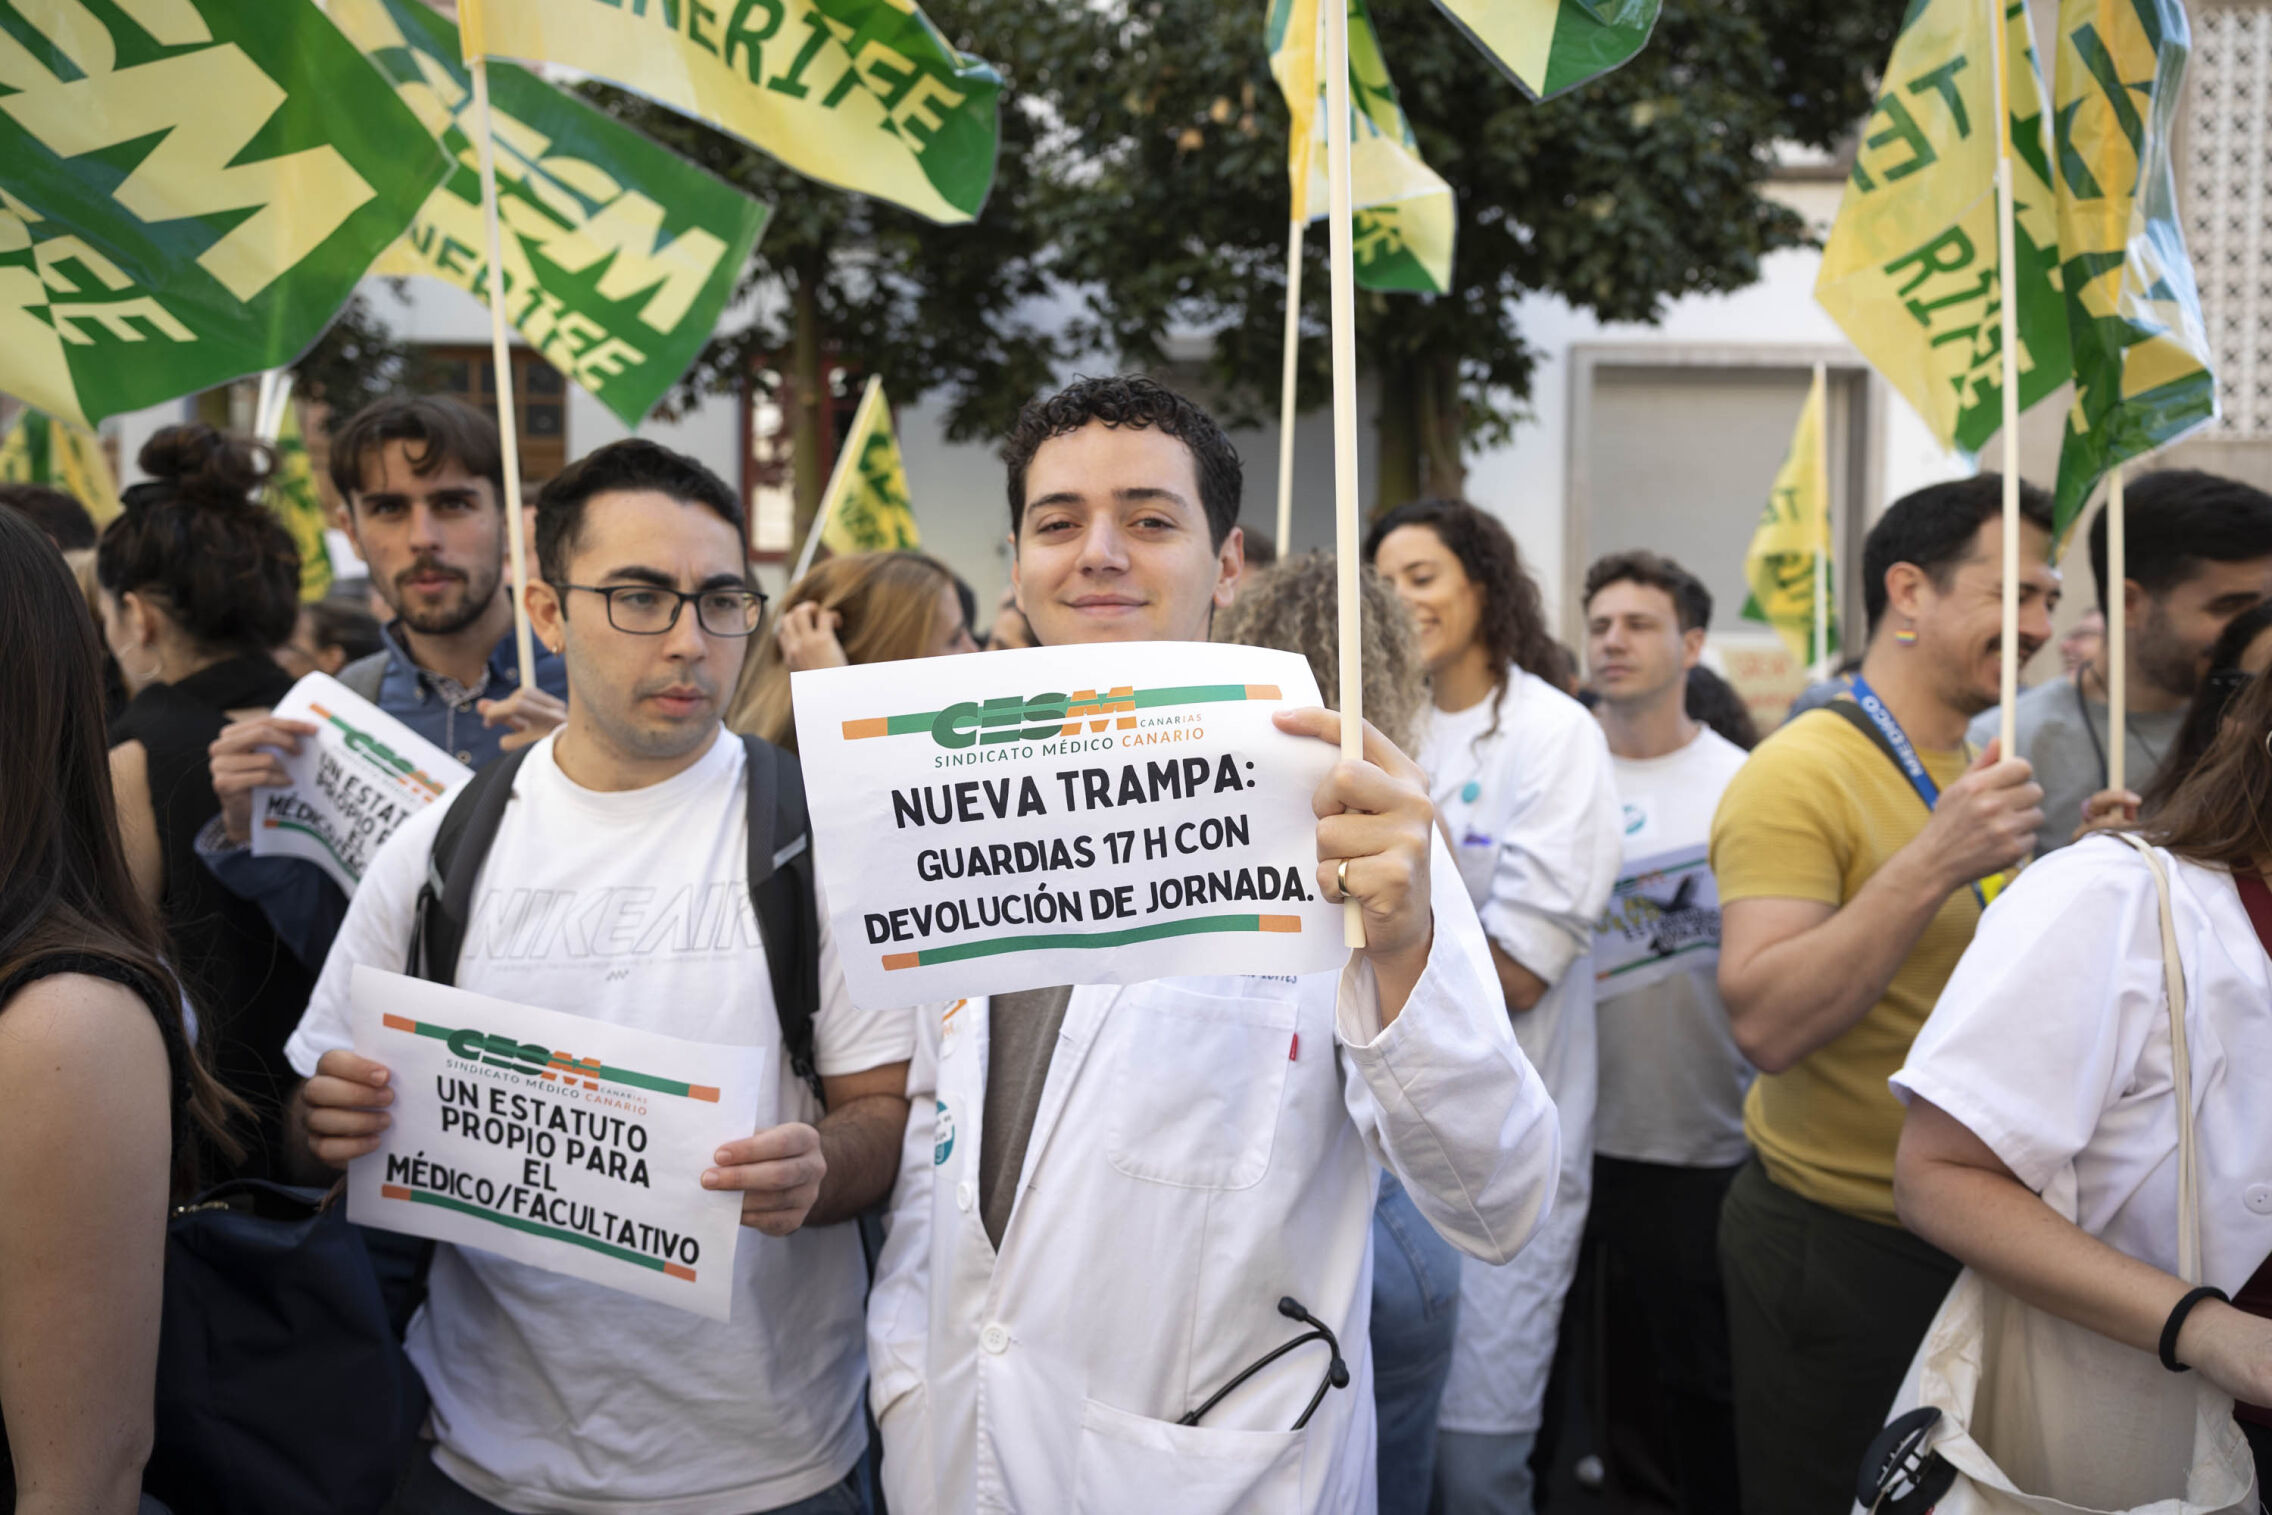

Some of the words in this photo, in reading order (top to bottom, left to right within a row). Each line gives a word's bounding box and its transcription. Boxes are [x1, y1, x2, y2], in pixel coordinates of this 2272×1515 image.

[931, 686, 1138, 750] CESM
[1140, 713, 1203, 728] CANARIAS
[934, 746, 1033, 769] SINDICATO
[1042, 737, 1114, 757] MÉDICO
[1122, 727, 1204, 748] CANARIO
[891, 775, 1047, 829] NUEVA
[1056, 753, 1256, 812] TRAMPA:
[917, 835, 1096, 882] GUARDIAS
[1103, 832, 1135, 865] 17
[1144, 826, 1168, 861] H
[1174, 814, 1250, 854] CON
[863, 882, 1084, 945] DEVOLUCIÓN
[1089, 885, 1137, 921] DE
[1146, 866, 1314, 914] JORNADA.
[446, 1059, 520, 1084] SINDICATO
[526, 1077, 580, 1098] MÉDICO
[585, 1093, 648, 1117] CANARIO
[447, 1029, 601, 1091] CESM
[437, 1075, 479, 1110] UN
[489, 1087, 647, 1153] ESTATUTO
[442, 1105, 556, 1159] PROPIO
[566, 1138, 650, 1189] PARA
[386, 1151, 700, 1265] MÉDICO/FACULTATIVO
[523, 1158, 557, 1192] EL
